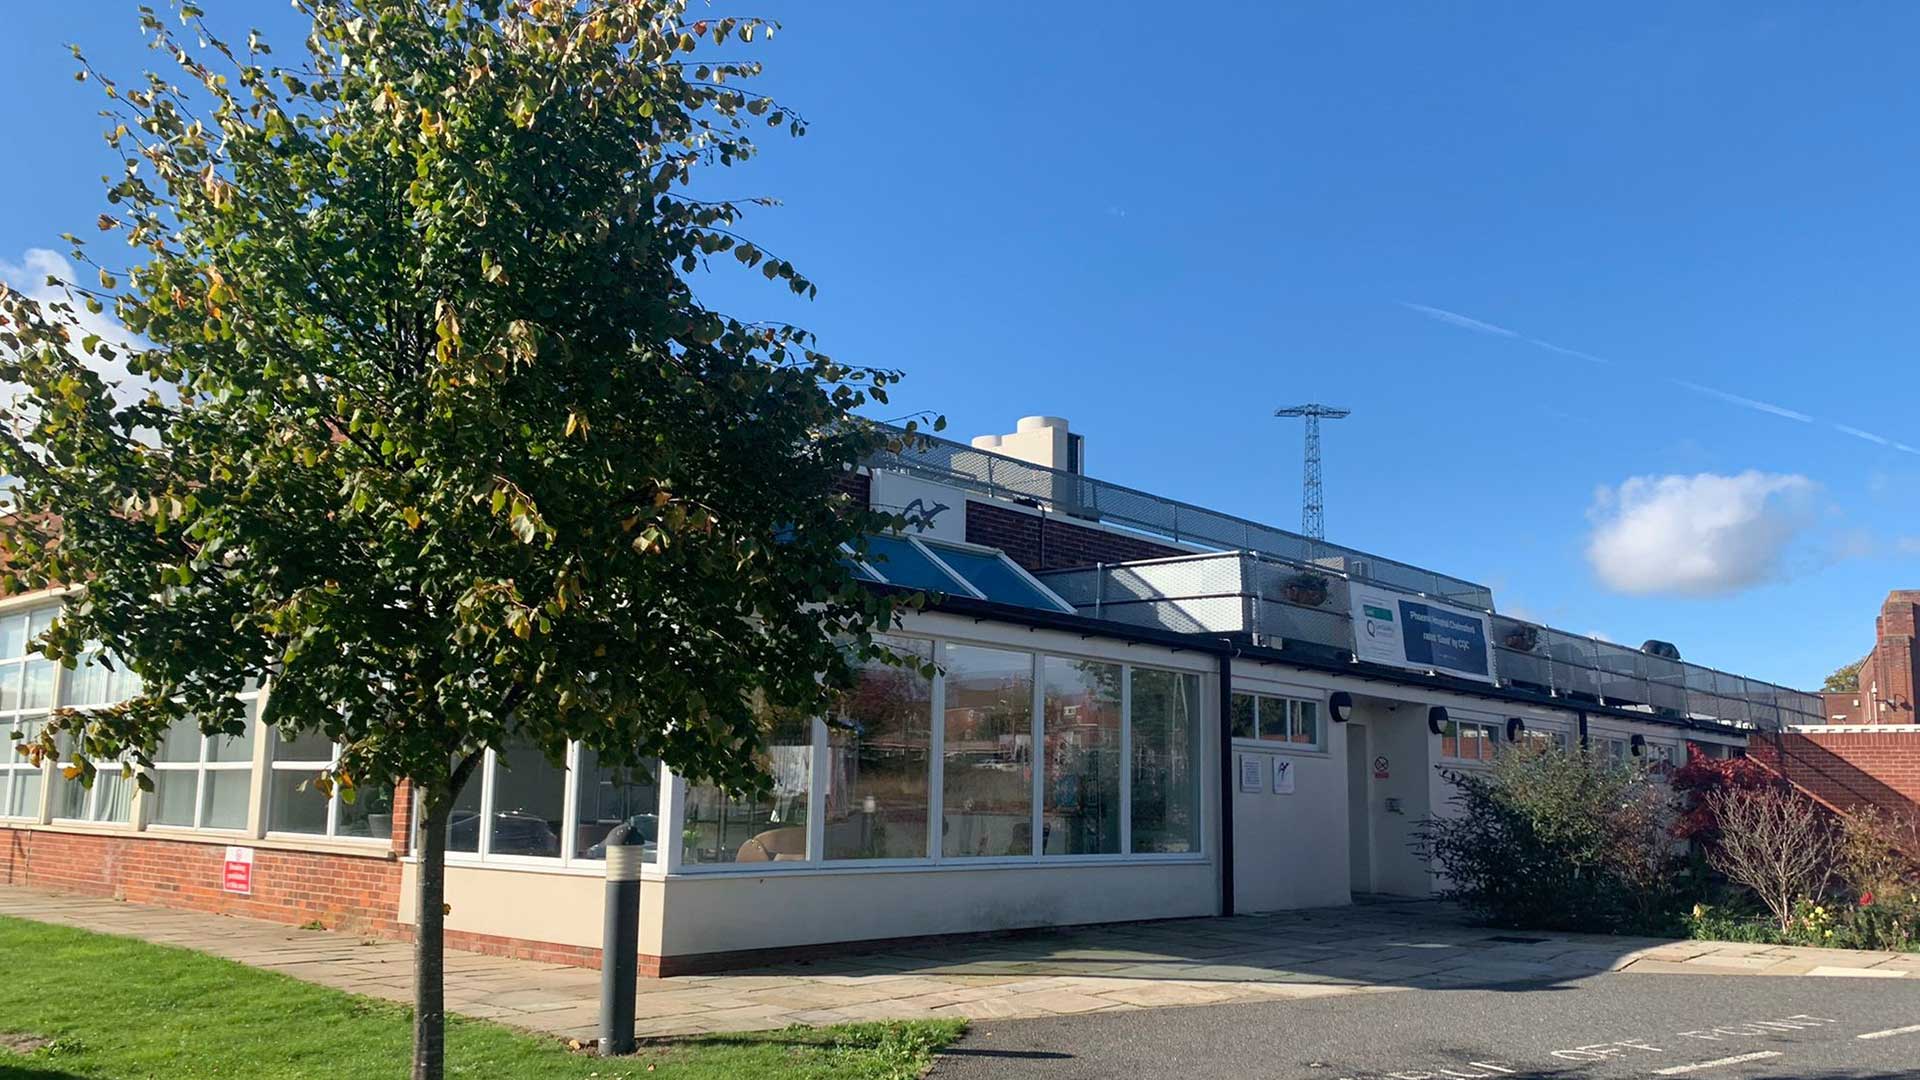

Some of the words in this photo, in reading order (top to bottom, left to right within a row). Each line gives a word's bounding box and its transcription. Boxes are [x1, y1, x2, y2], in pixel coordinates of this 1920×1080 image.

[1458, 639, 1471, 651] CQC
[1550, 1039, 1662, 1061] OFF
[1676, 1015, 1836, 1040] POINT
